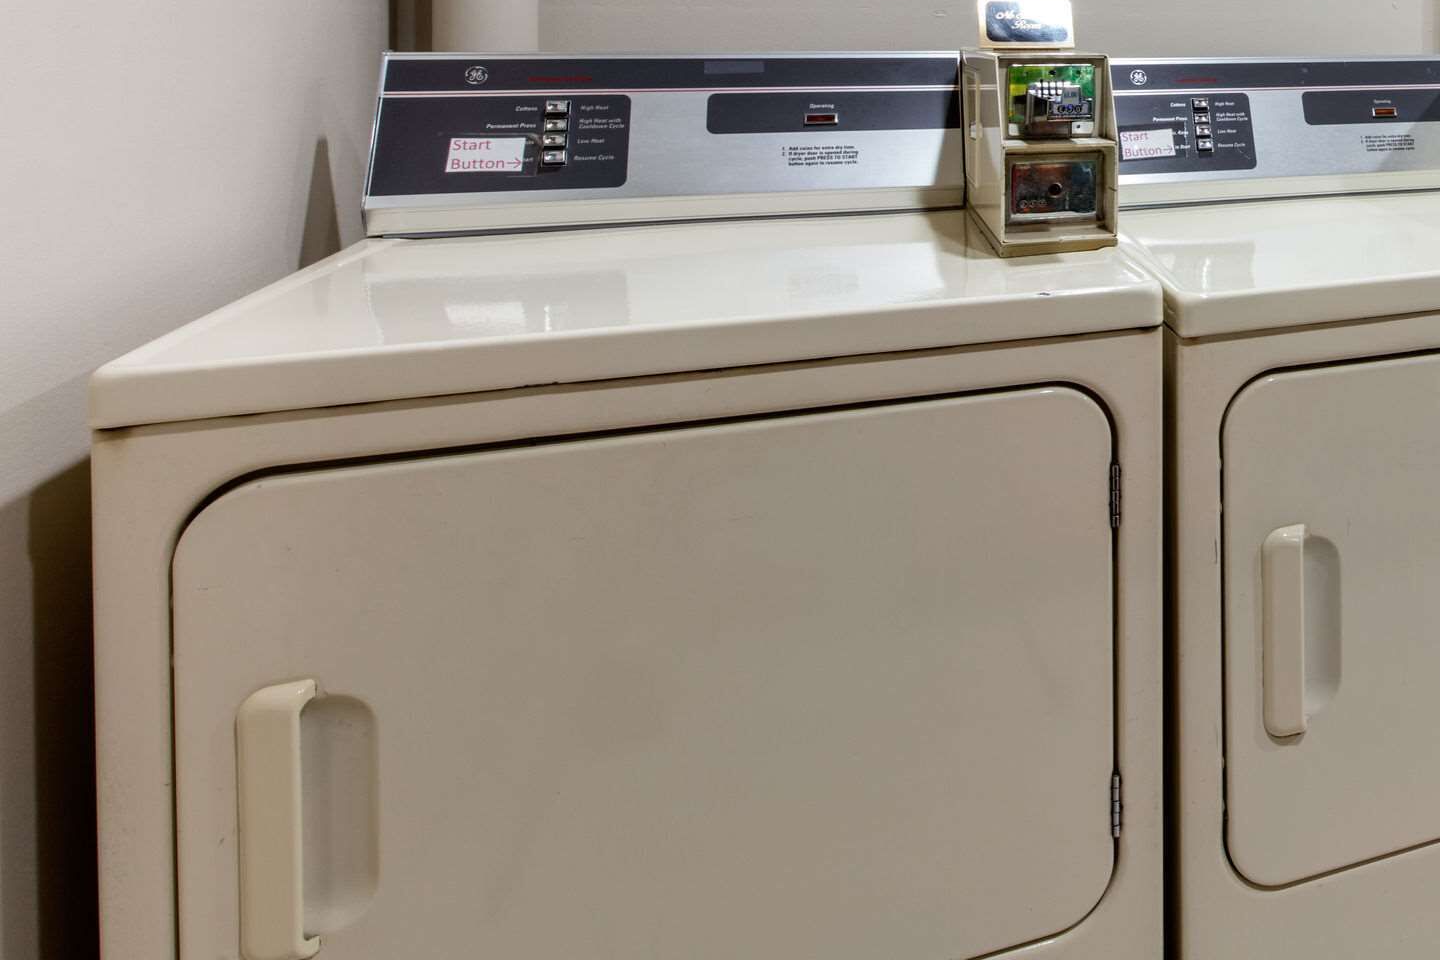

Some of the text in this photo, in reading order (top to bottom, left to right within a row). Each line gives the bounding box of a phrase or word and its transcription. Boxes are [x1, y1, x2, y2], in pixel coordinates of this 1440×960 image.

[1122, 133, 1148, 142] Start
[453, 140, 491, 150] Start
[1124, 147, 1162, 157] Button
[451, 159, 504, 169] Button
